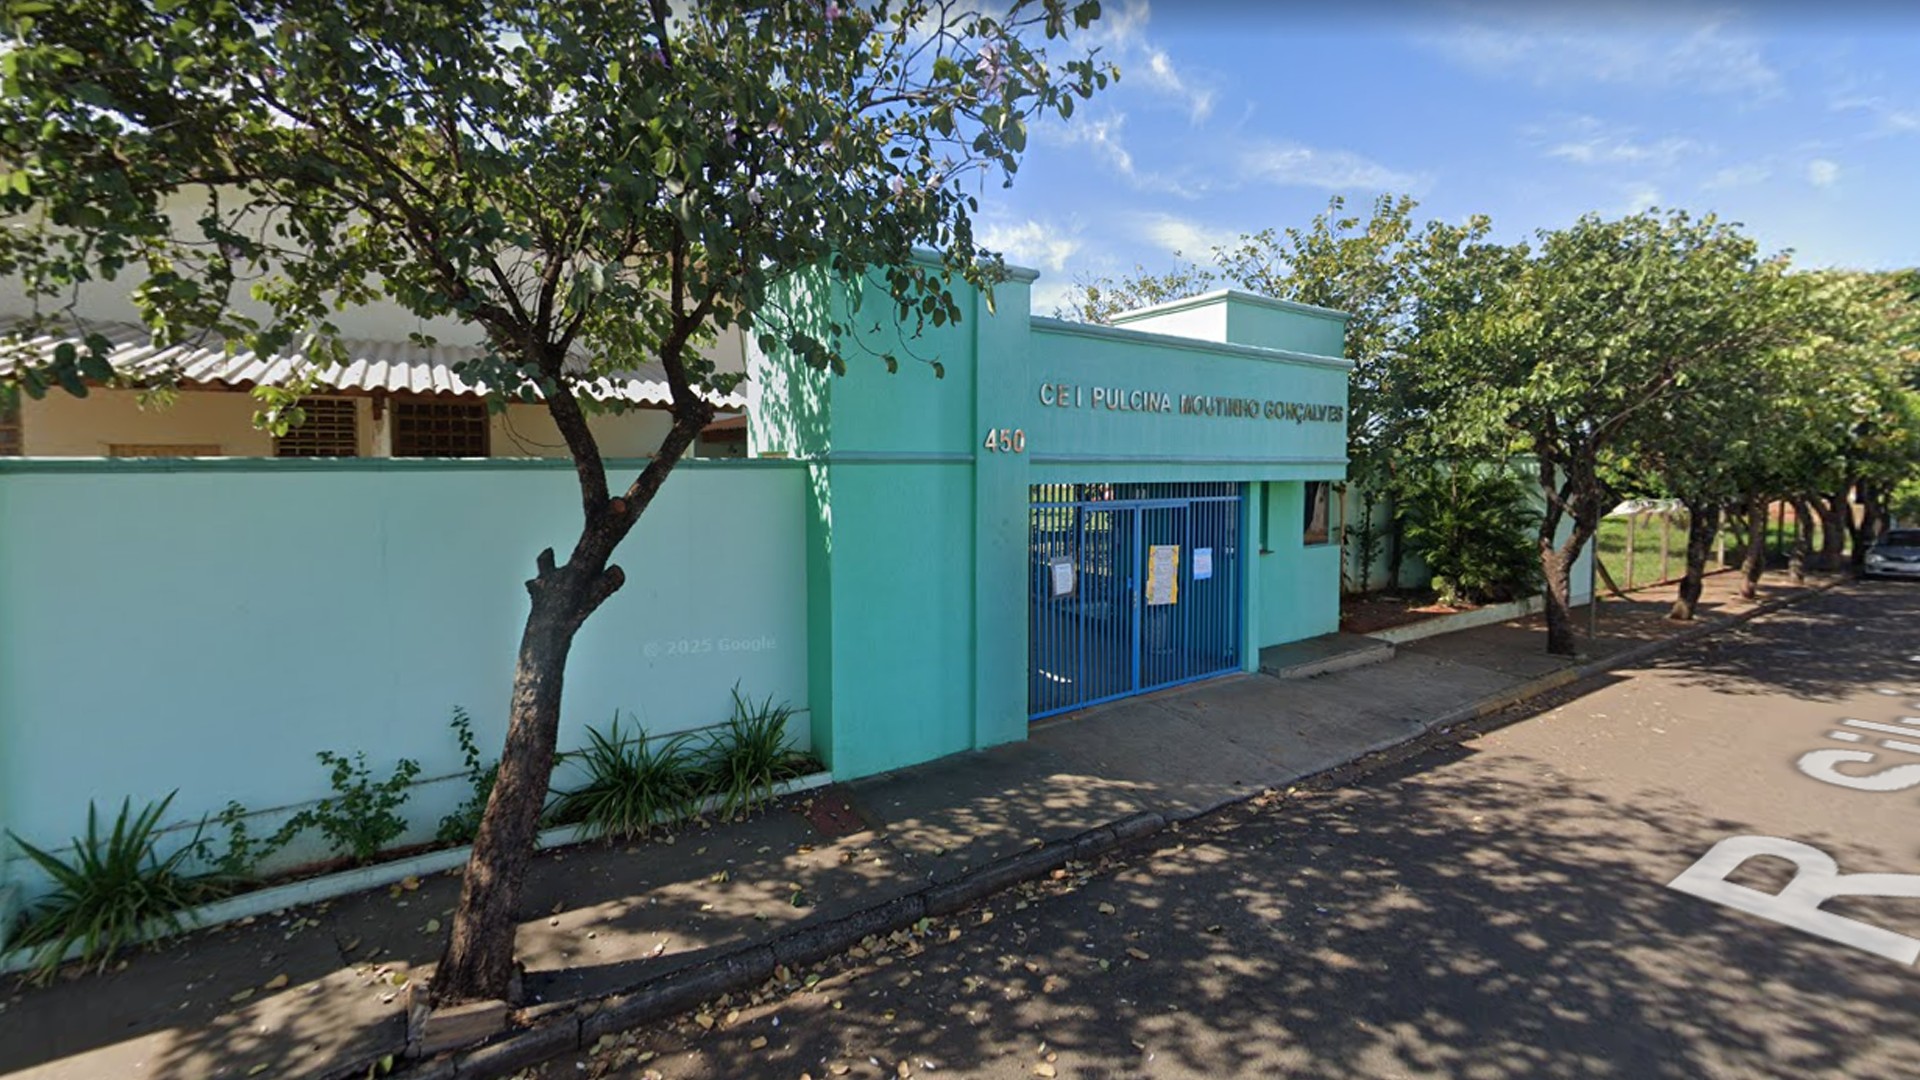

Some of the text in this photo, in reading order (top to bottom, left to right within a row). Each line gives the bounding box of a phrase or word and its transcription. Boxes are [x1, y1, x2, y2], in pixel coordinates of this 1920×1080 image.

[1092, 387, 1171, 412] PULCINA
[1179, 394, 1259, 419] MOUTINHO
[1263, 400, 1343, 424] GONÇALVES
[984, 428, 1025, 453] 450
